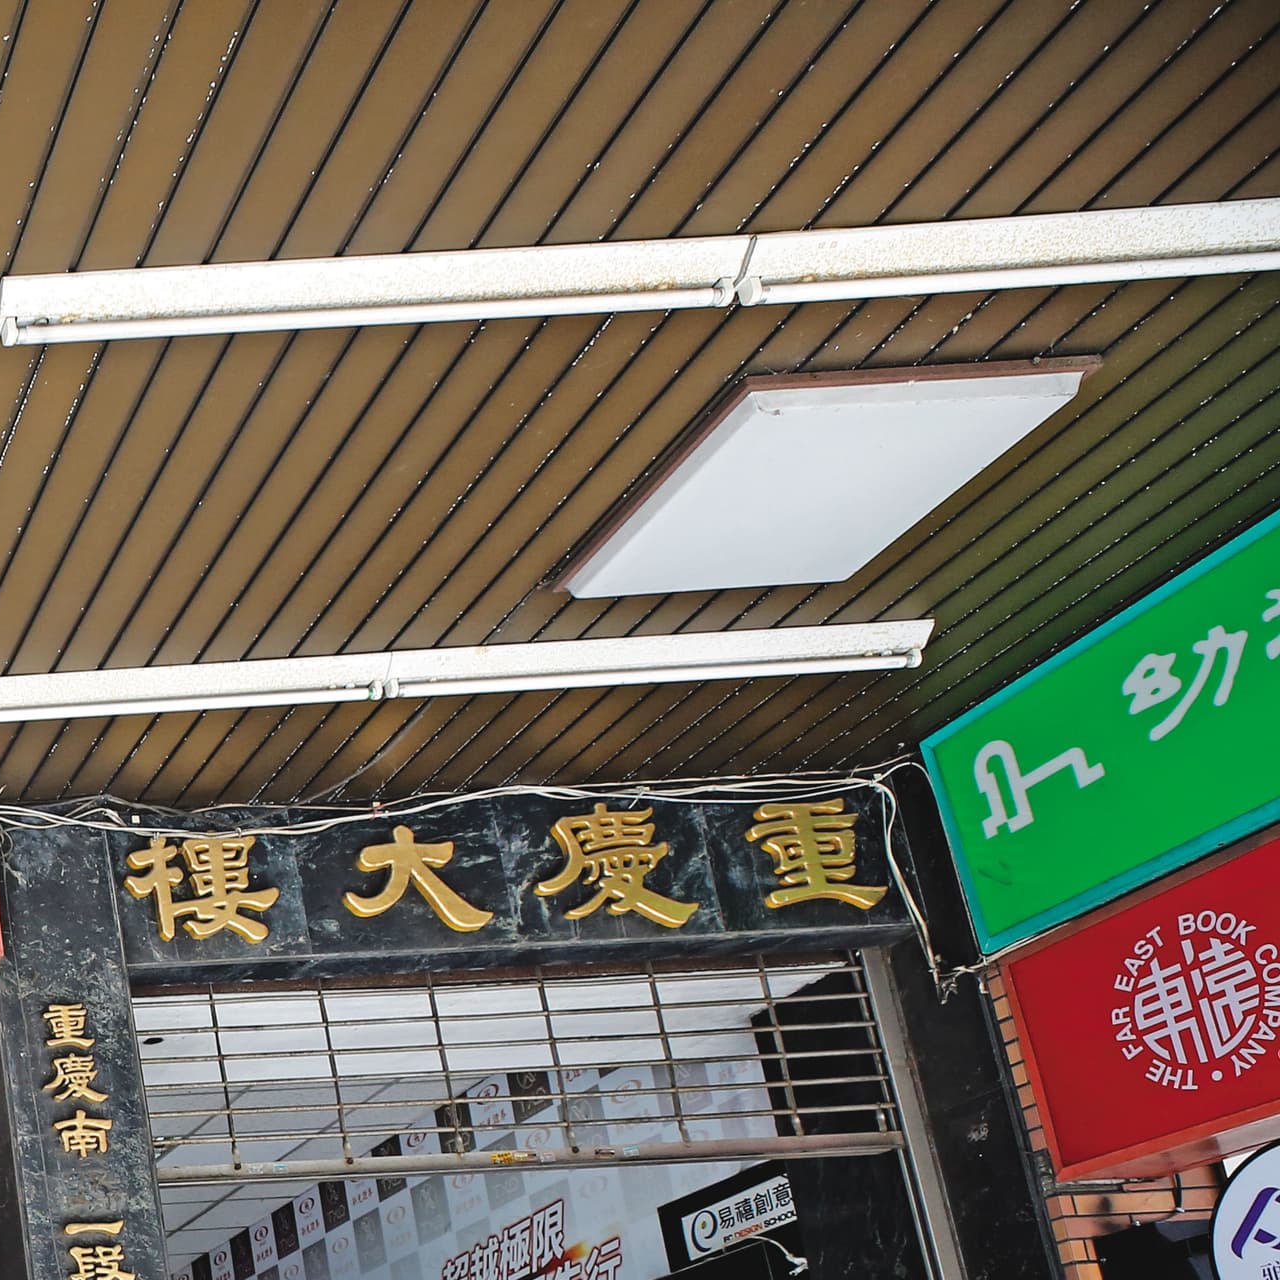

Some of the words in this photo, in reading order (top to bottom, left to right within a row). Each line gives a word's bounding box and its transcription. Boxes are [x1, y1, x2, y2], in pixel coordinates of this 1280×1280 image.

[1122, 588, 1280, 741] 幼
[123, 797, 889, 944] 重慶大樓
[1114, 926, 1164, 992] EAST
[1177, 910, 1256, 945] BOOK
[1111, 1006, 1144, 1060] FAR
[1230, 944, 1280, 1076] COMPANY
[1145, 1059, 1198, 1090] THE
